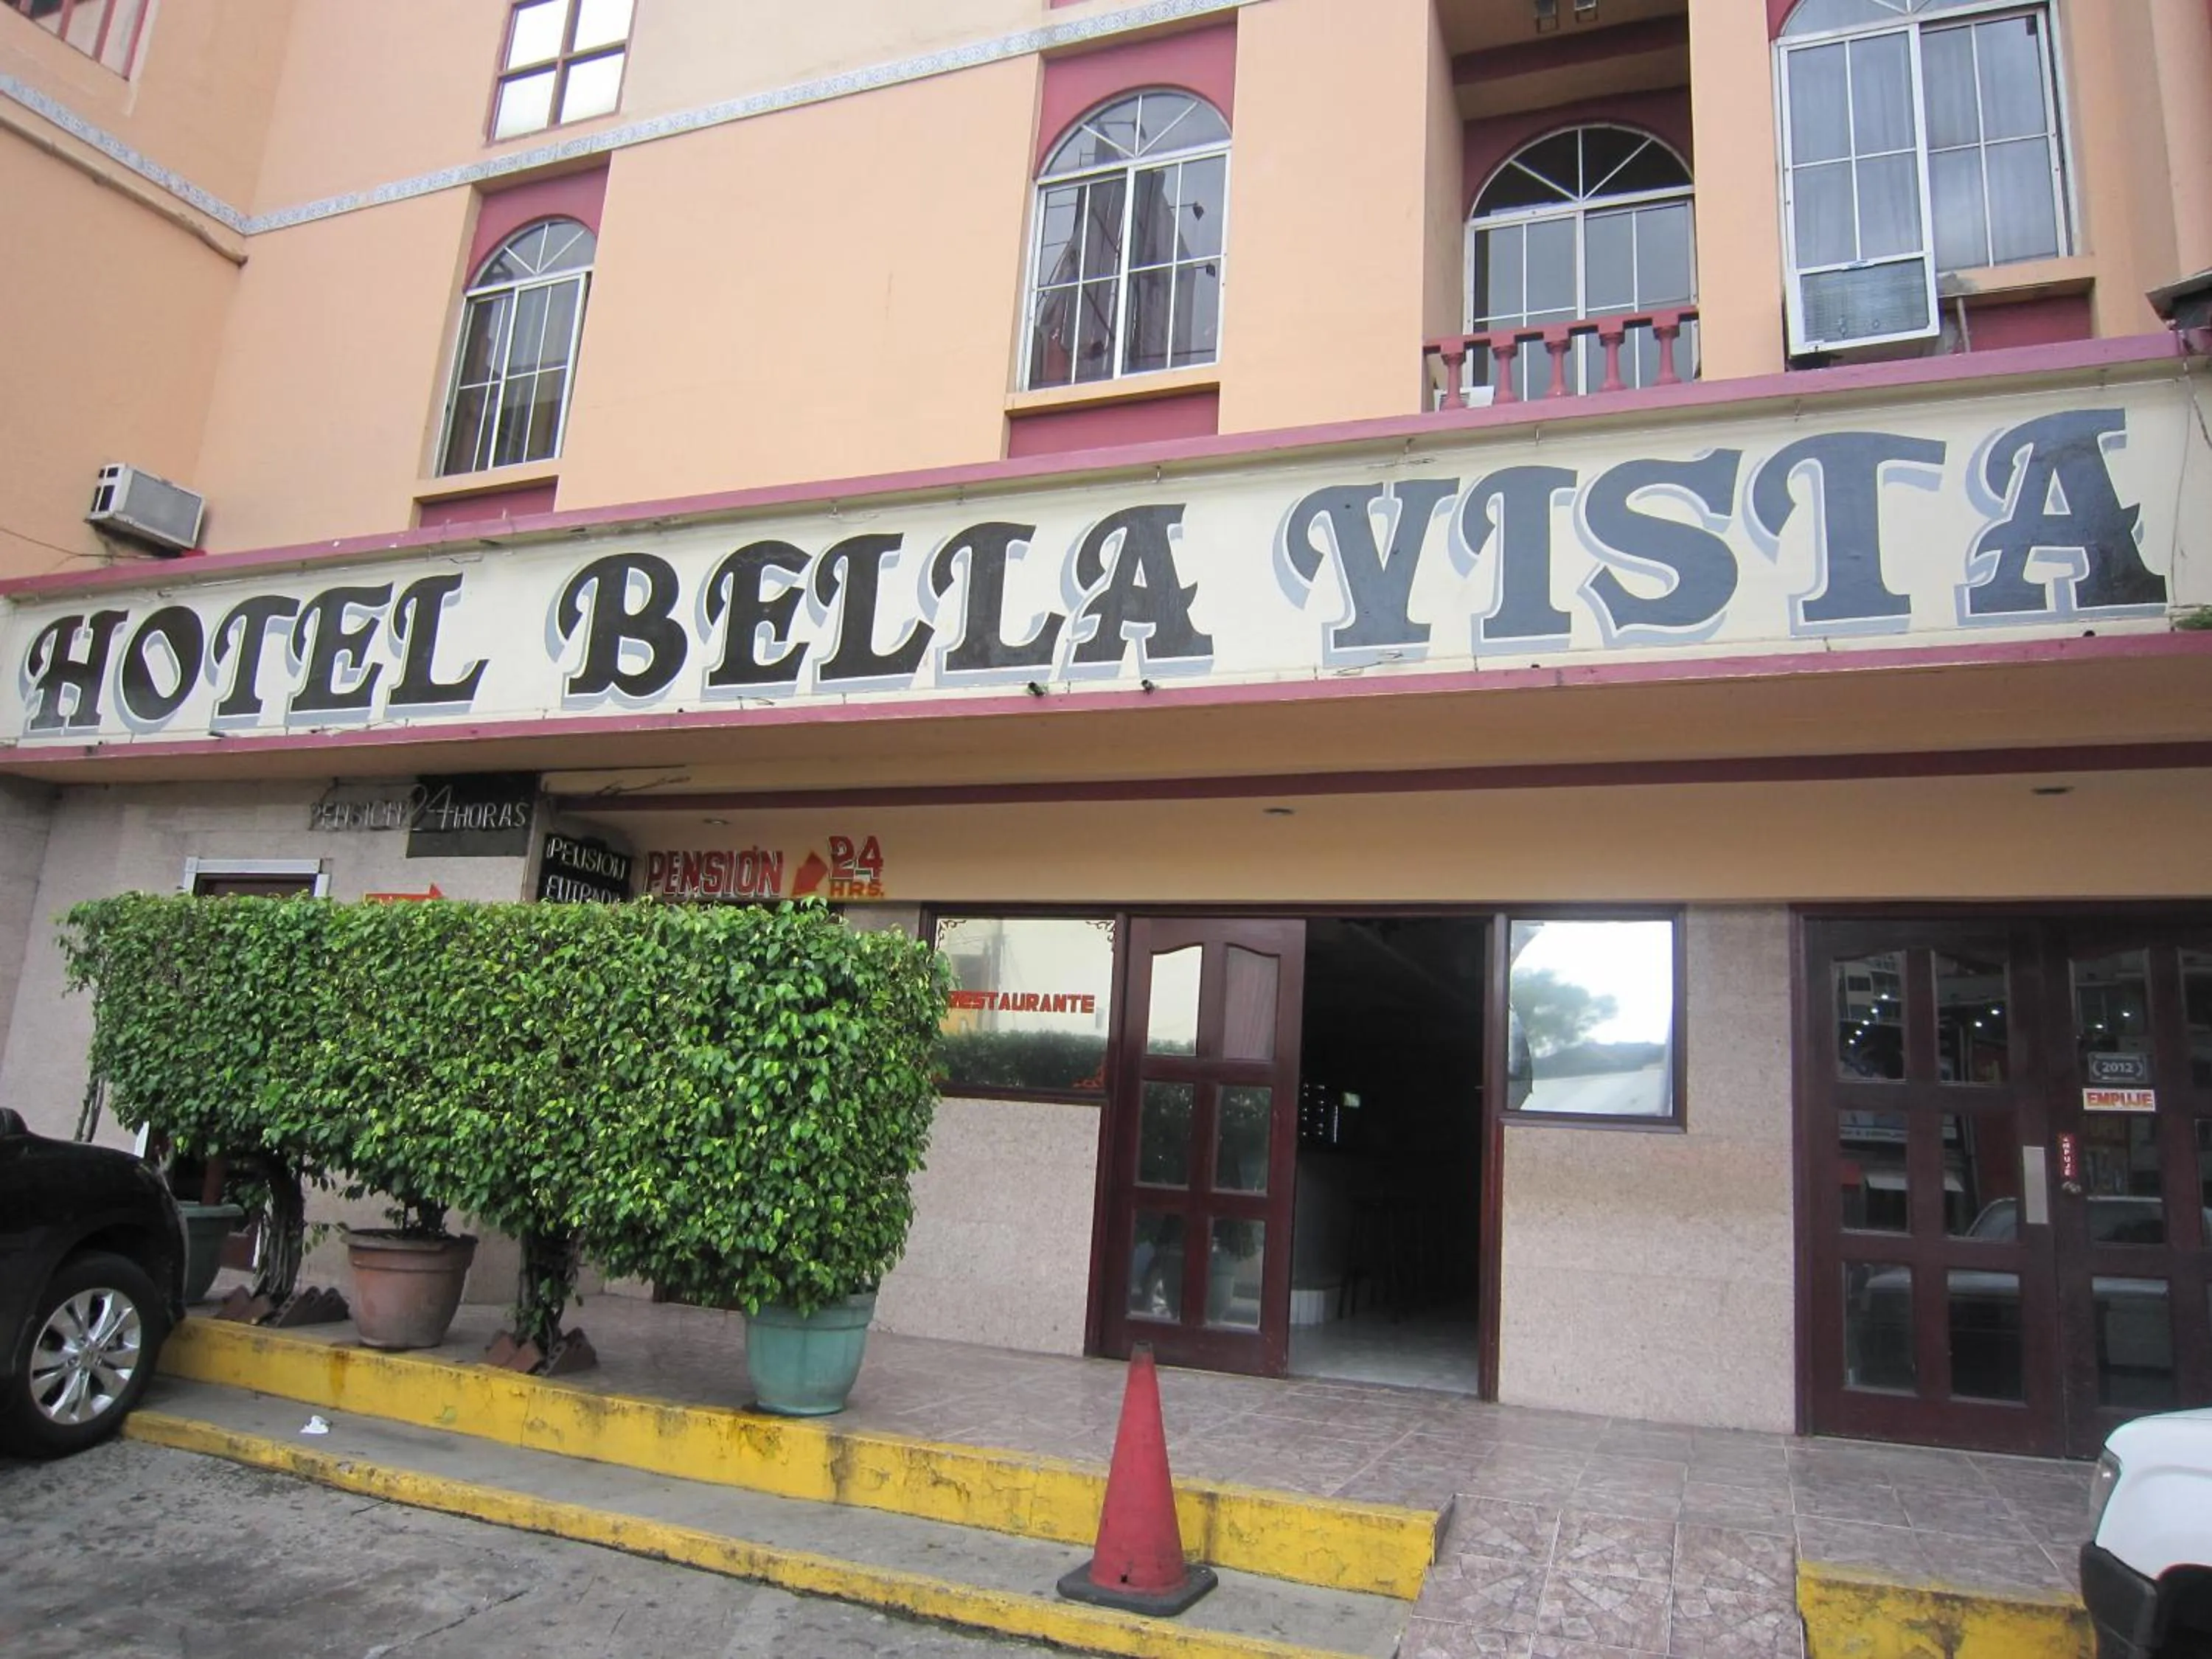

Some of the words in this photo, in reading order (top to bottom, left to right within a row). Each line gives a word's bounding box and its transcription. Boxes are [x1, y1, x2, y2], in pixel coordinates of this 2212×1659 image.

[25, 571, 489, 731] HOTEL
[547, 501, 1215, 705] BELLA
[1273, 408, 2169, 662] VISTA
[410, 783, 454, 831] 24
[453, 801, 529, 830] HORAS
[827, 835, 884, 880] 24
[830, 880, 885, 897] HRS.
[947, 990, 1096, 1014] RESTAURANTE
[2101, 1062, 2134, 1073] 2012
[2087, 1092, 2153, 1107] EMPUJE
